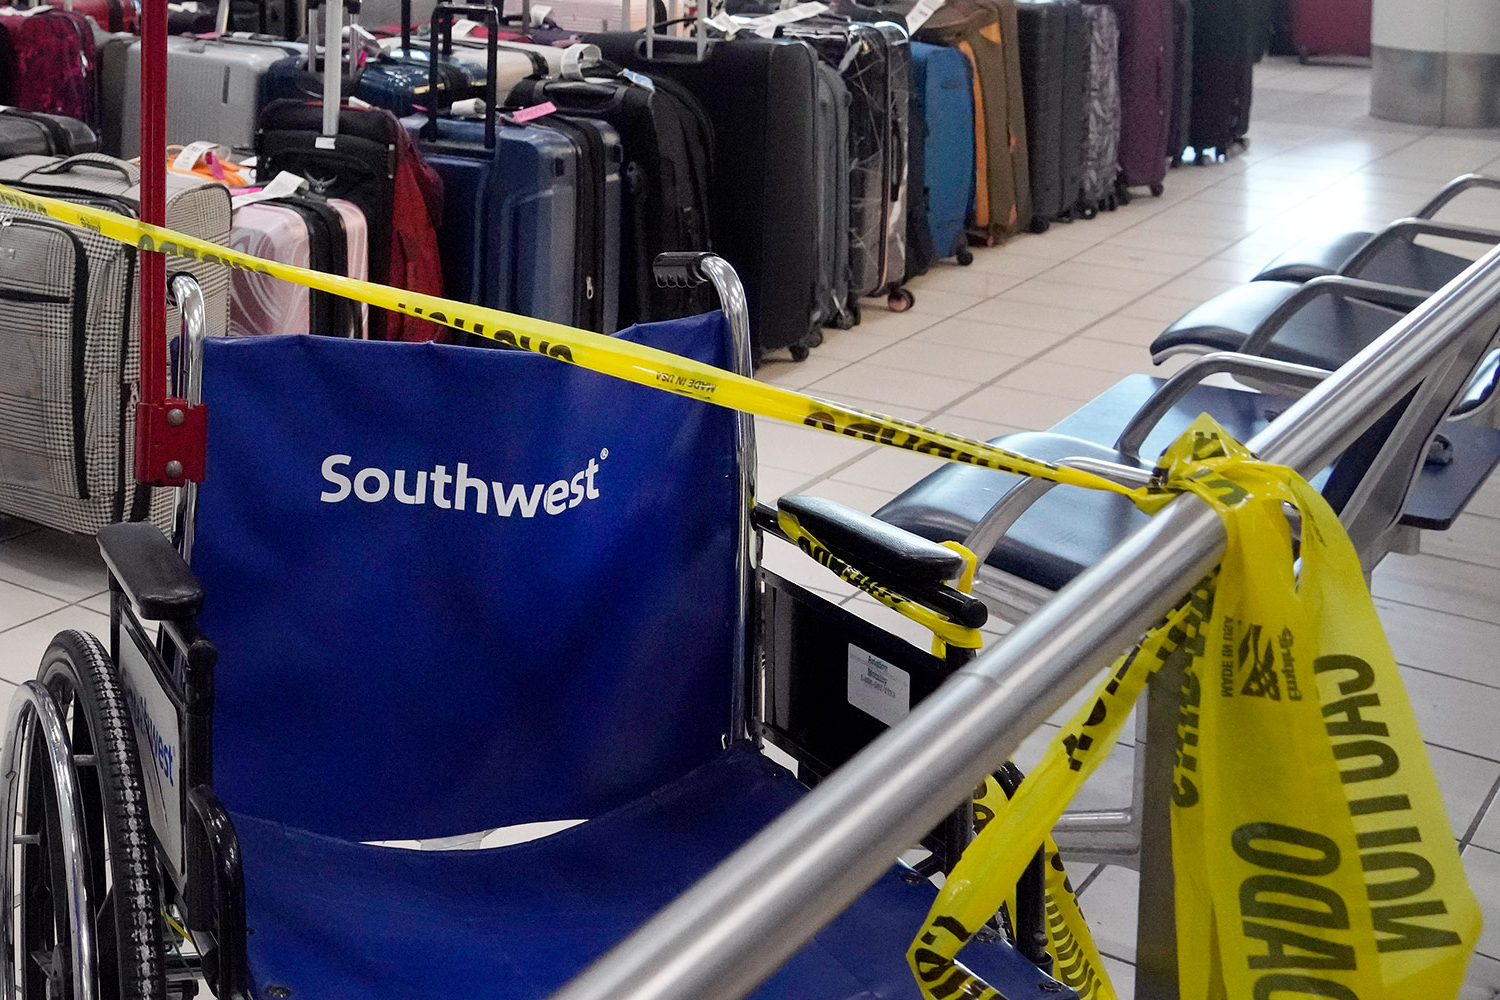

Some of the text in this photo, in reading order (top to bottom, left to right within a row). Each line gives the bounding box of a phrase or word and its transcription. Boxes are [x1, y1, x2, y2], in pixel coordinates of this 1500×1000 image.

[656, 370, 717, 393] MADE IN USA
[319, 453, 601, 519] Southwest
